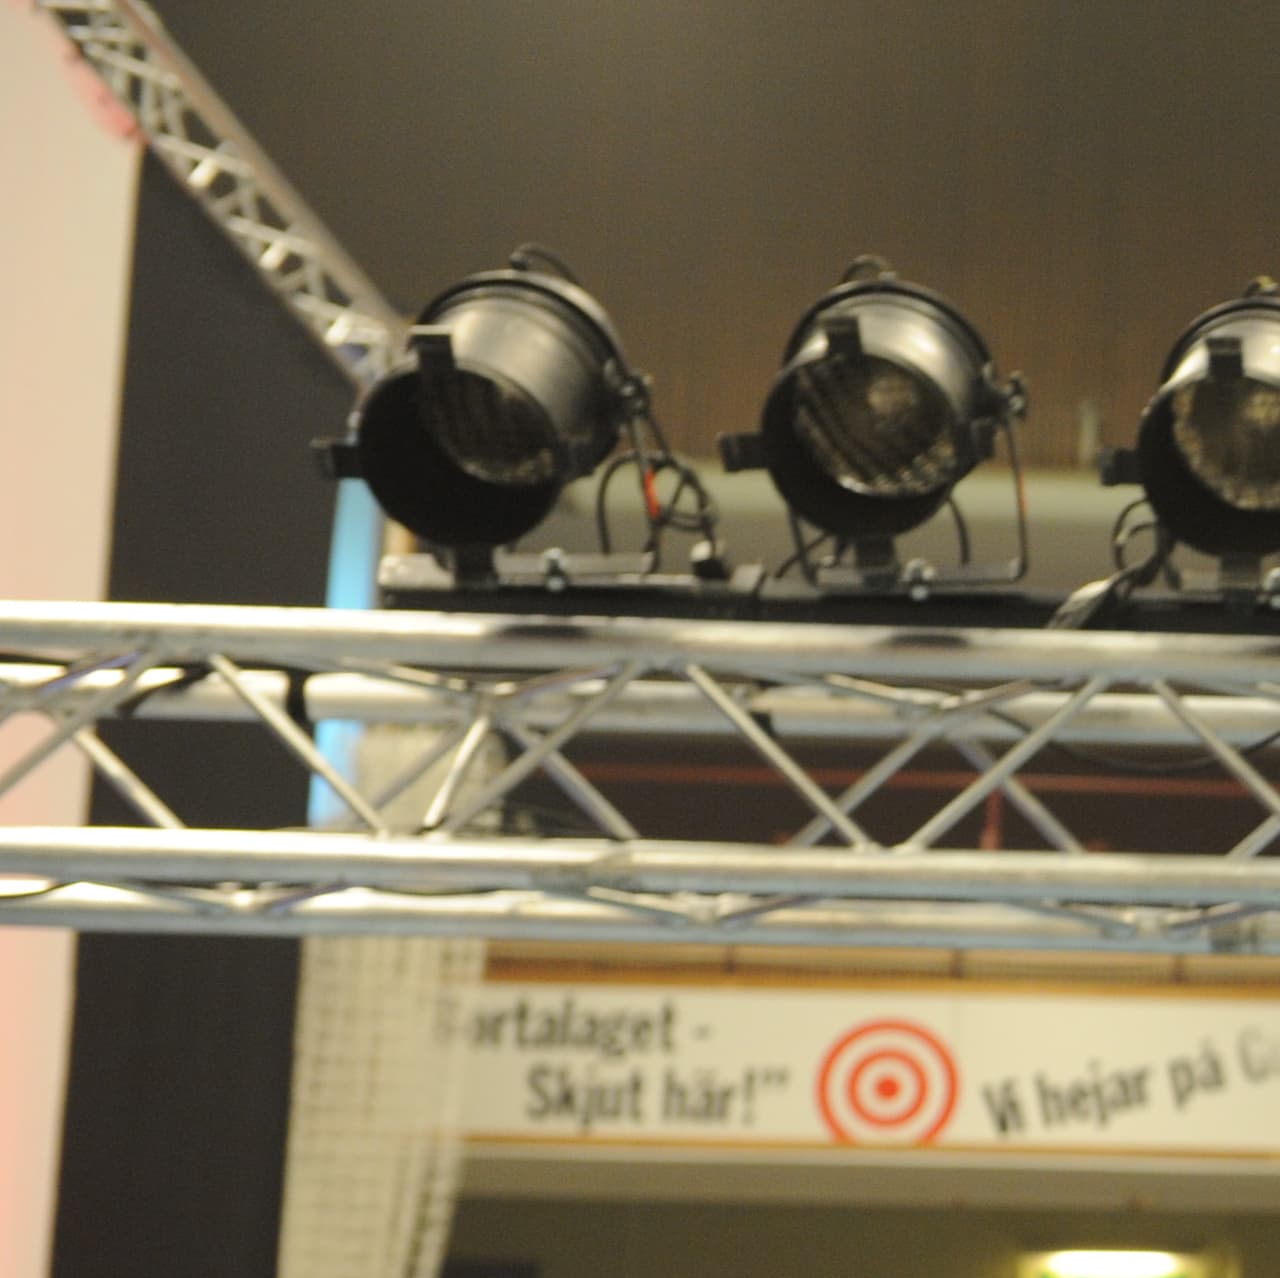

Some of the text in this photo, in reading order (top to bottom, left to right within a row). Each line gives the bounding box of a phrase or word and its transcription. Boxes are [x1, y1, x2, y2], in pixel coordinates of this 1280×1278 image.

[525, 1064, 645, 1133] Skjut
[1033, 1058, 1151, 1129] hejar
[1166, 1038, 1226, 1109] på
